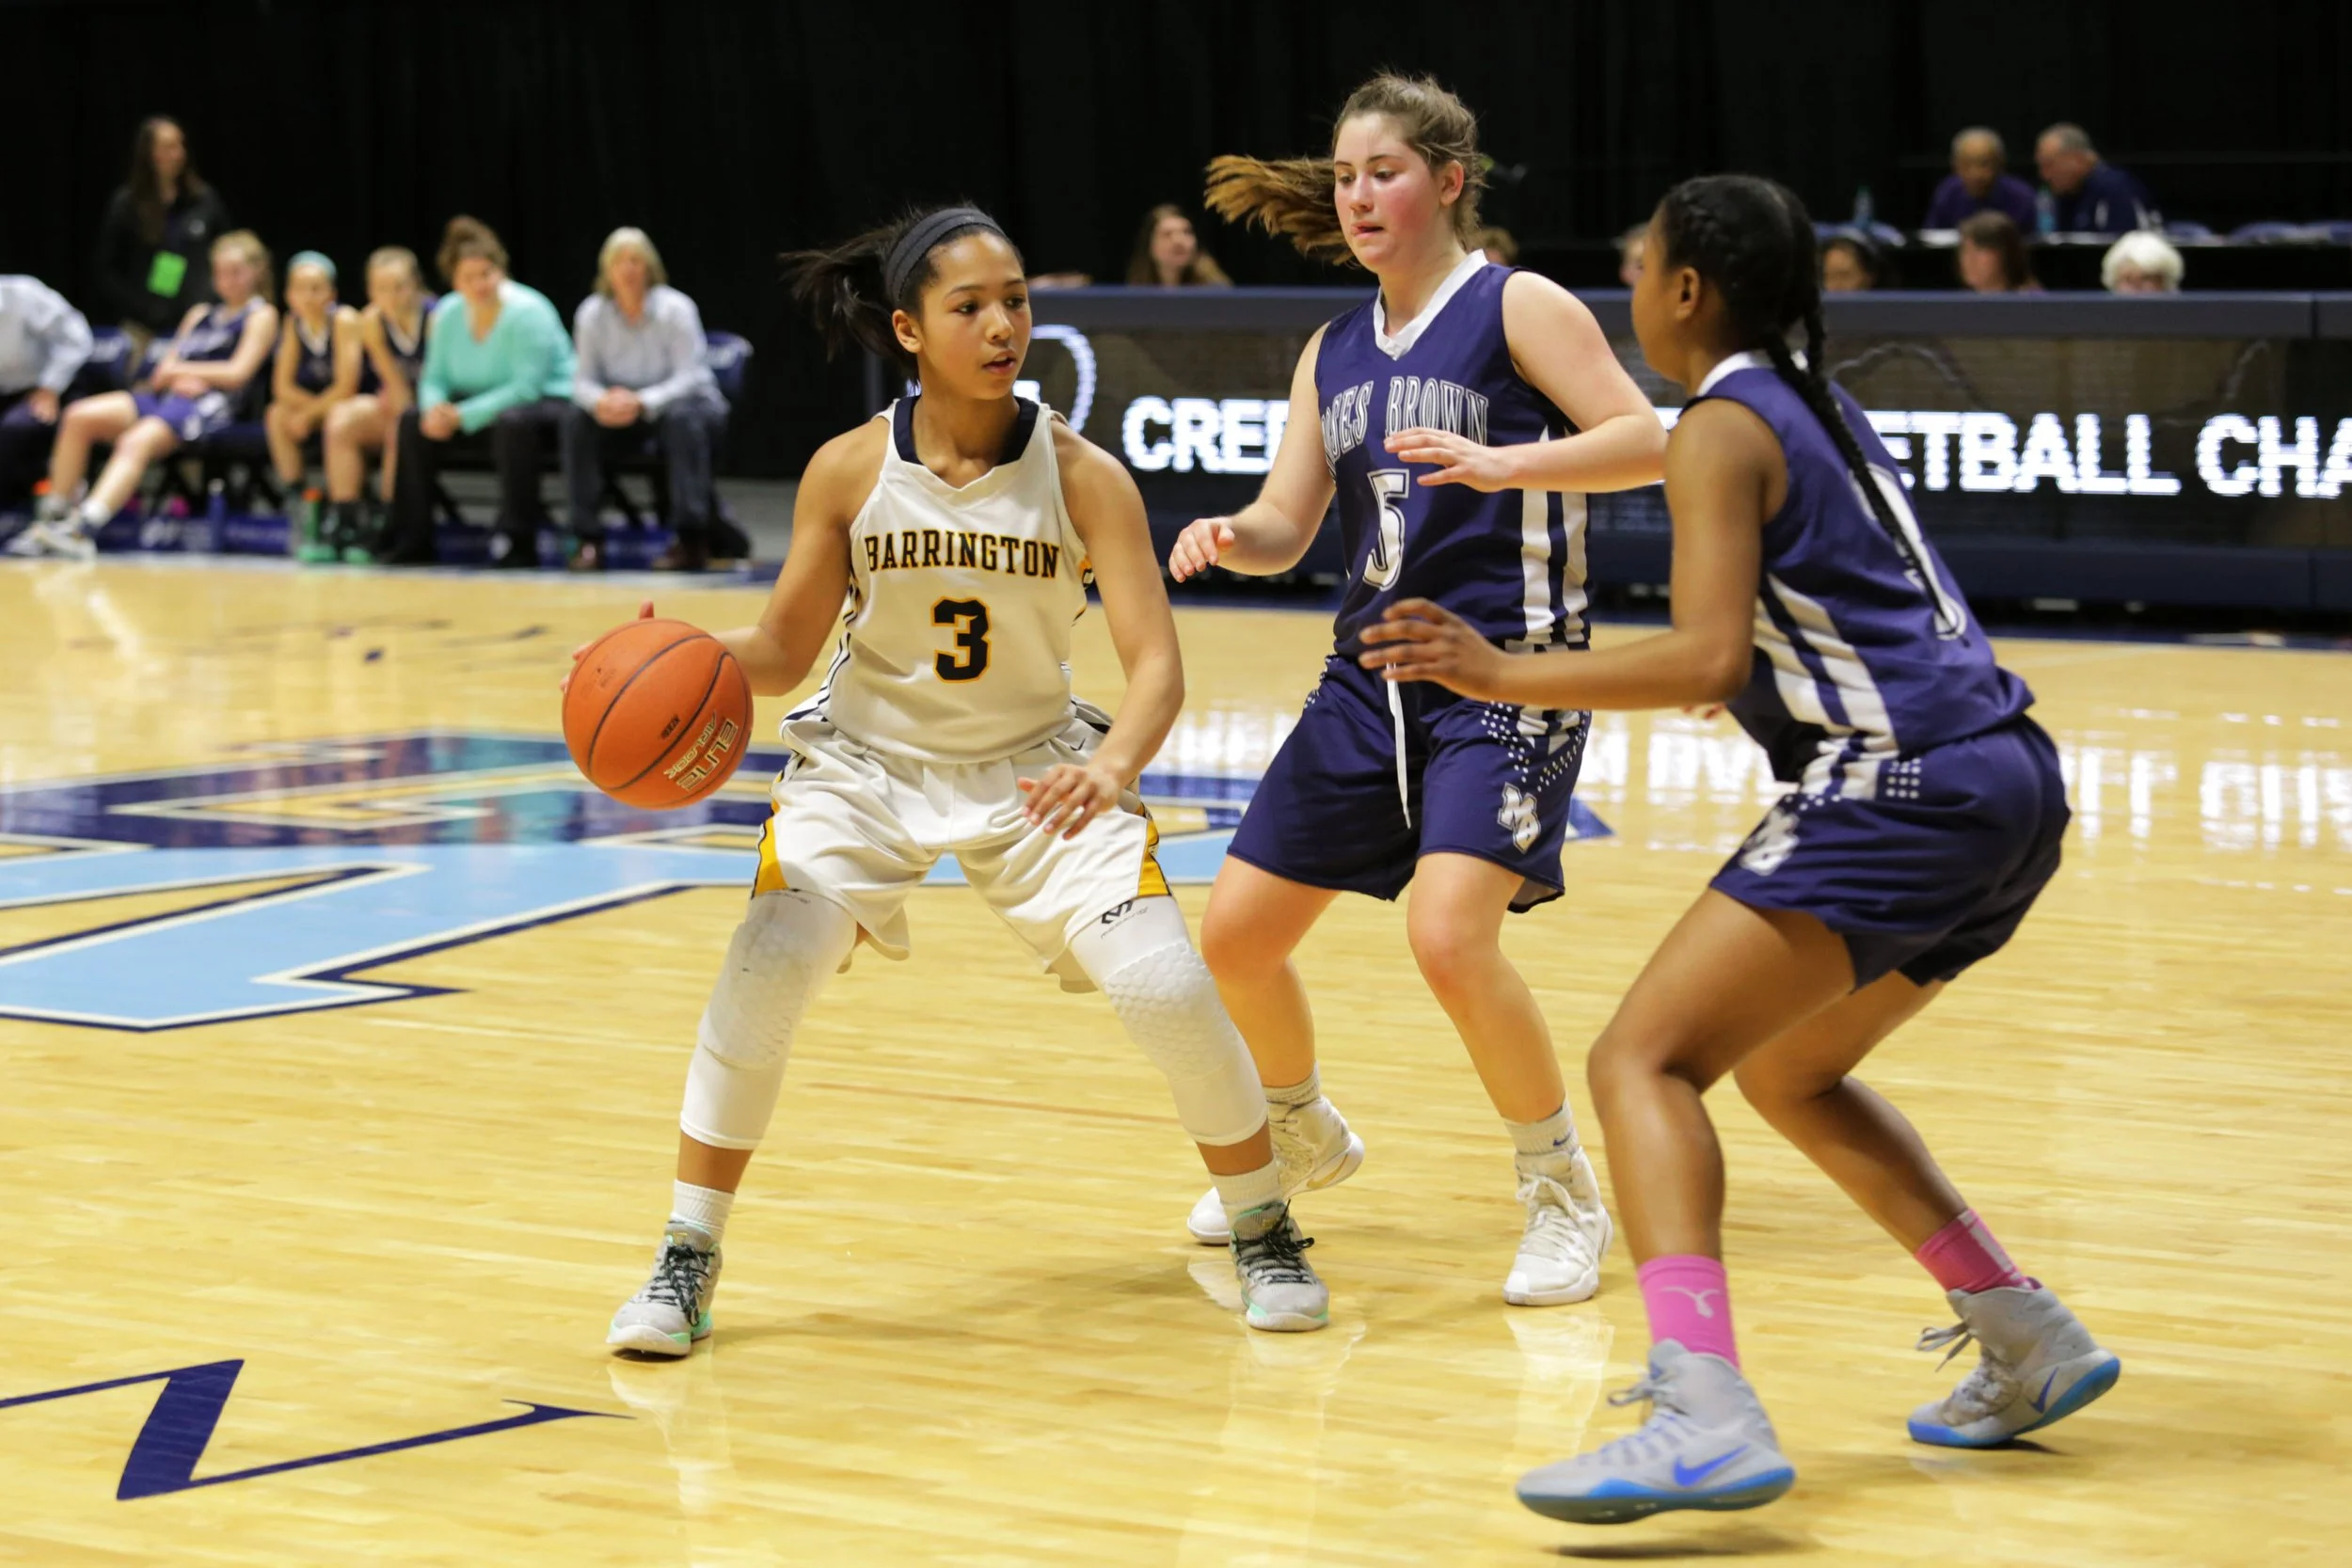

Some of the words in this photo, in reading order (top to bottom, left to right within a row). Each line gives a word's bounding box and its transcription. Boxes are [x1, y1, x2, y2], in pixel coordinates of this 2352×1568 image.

[1386, 376, 1489, 448] BROWN
[864, 530, 1060, 578] BARRINGTON
[1363, 468, 1410, 592] 5
[930, 596, 992, 684] 3
[675, 718, 739, 792] ELITE
